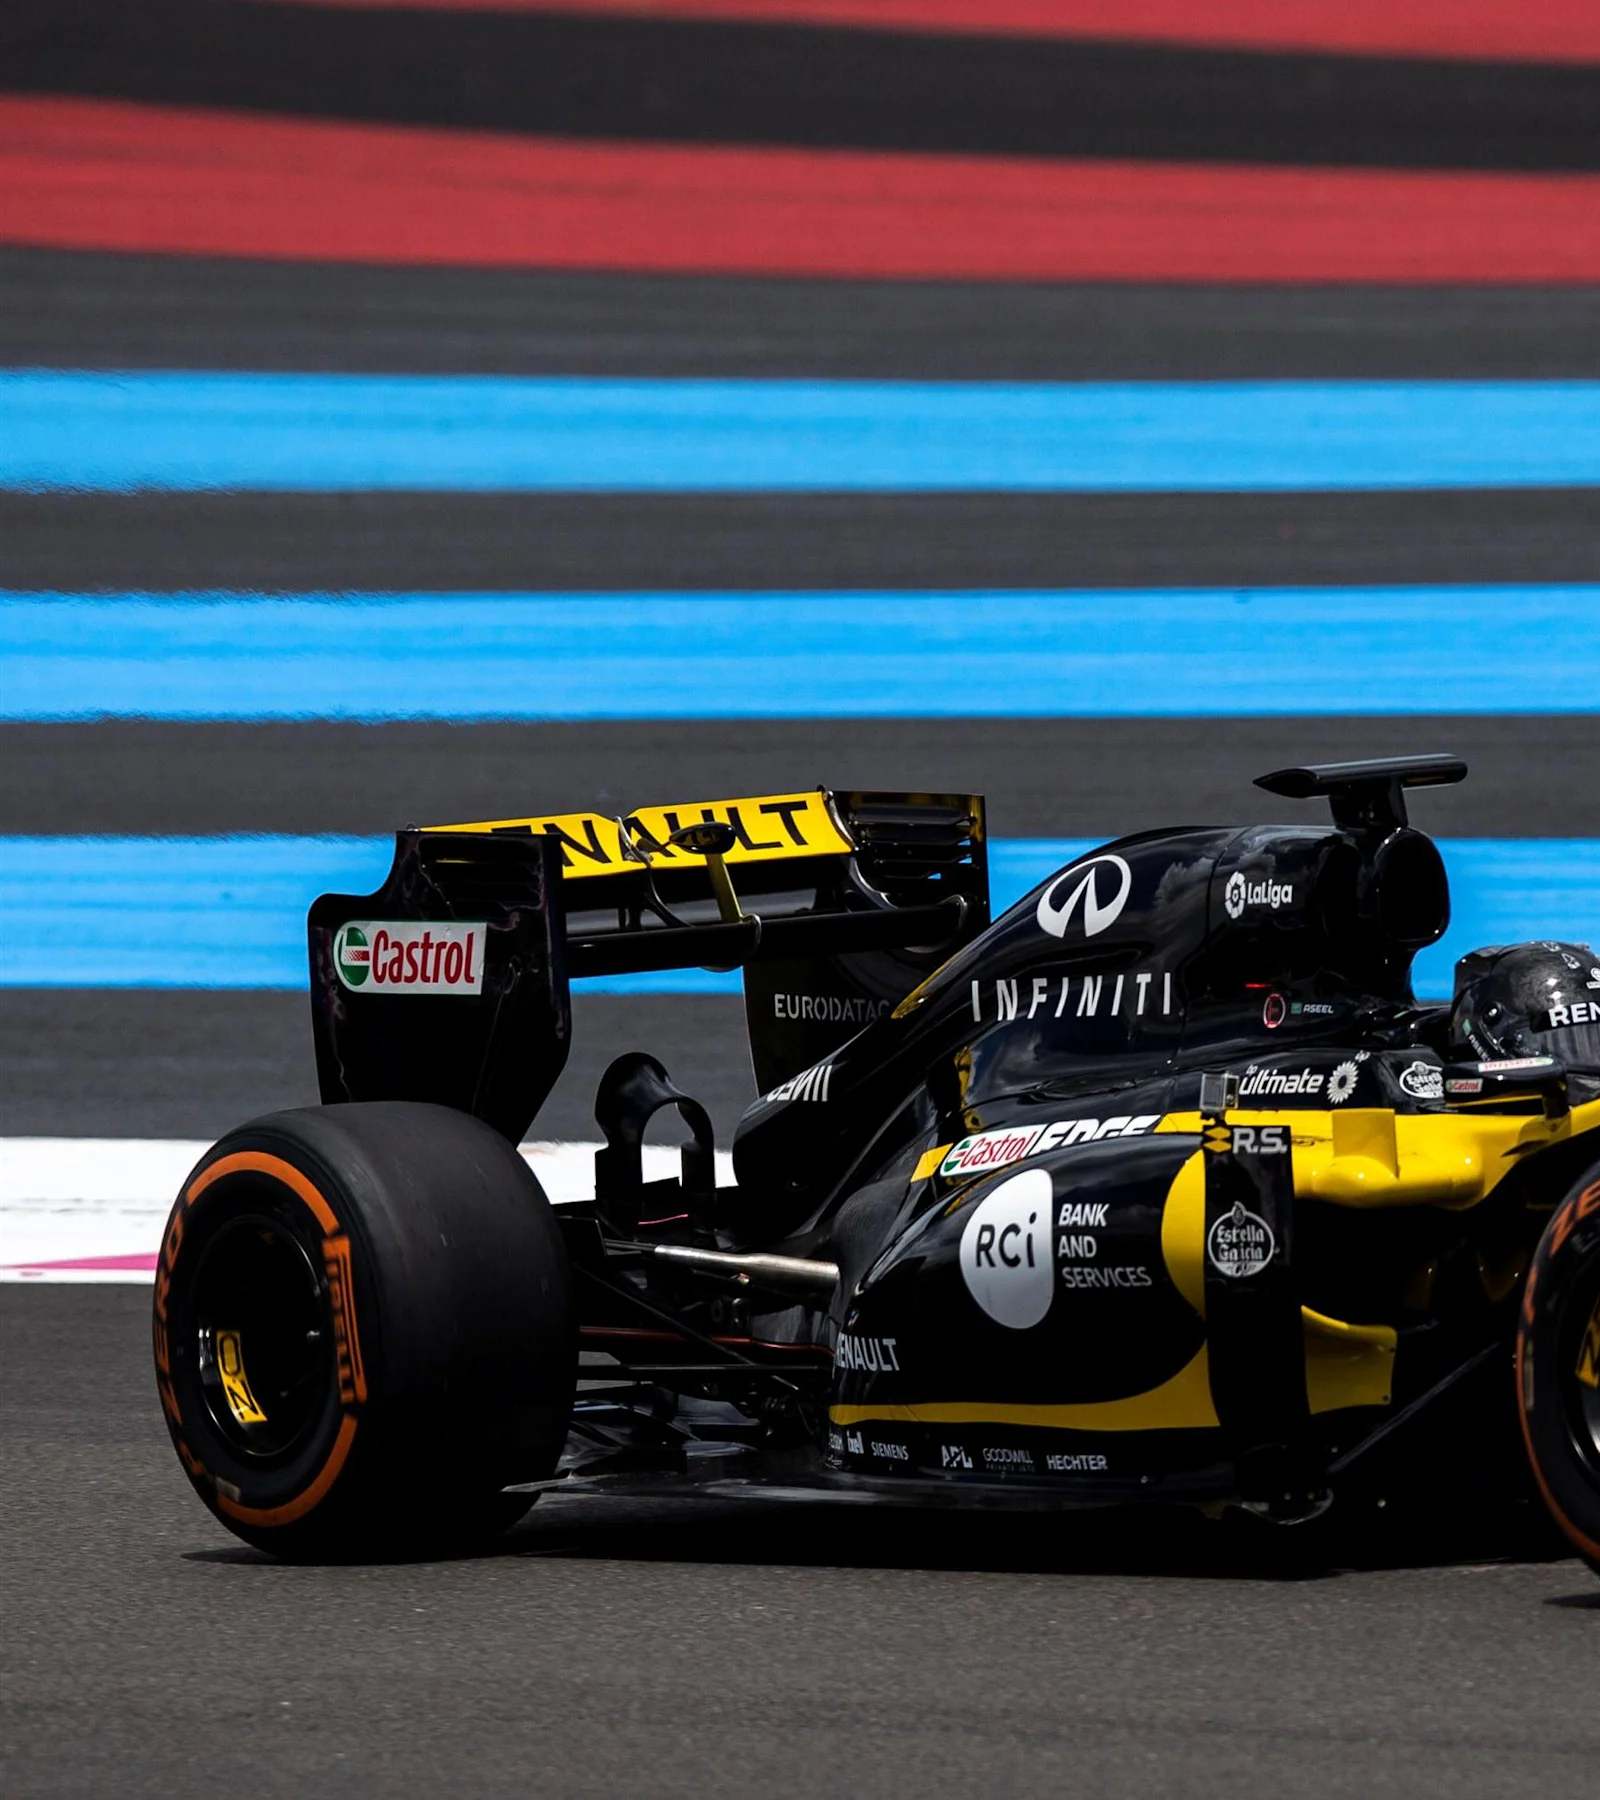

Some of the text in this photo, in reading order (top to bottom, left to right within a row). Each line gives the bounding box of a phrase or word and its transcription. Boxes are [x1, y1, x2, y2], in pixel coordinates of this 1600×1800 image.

[1247, 879, 1293, 909] LaLiga
[372, 929, 476, 985] Castrol
[971, 973, 1172, 1022] INFINITI
[1239, 1067, 1324, 1096] ultimate
[960, 1131, 1038, 1168] Castrol
[1232, 1127, 1288, 1154] R.S.
[1058, 1203, 1109, 1227] BANK
[1216, 1224, 1265, 1244] Estrella
[1058, 1235, 1097, 1258] AND
[1218, 1243, 1263, 1262] Gaicia
[1062, 1267, 1152, 1289] SERVICES
[871, 1441, 909, 1461] SIEMENS
[982, 1447, 1034, 1464] GOODWILL
[1046, 1454, 1109, 1472] HECHTER
